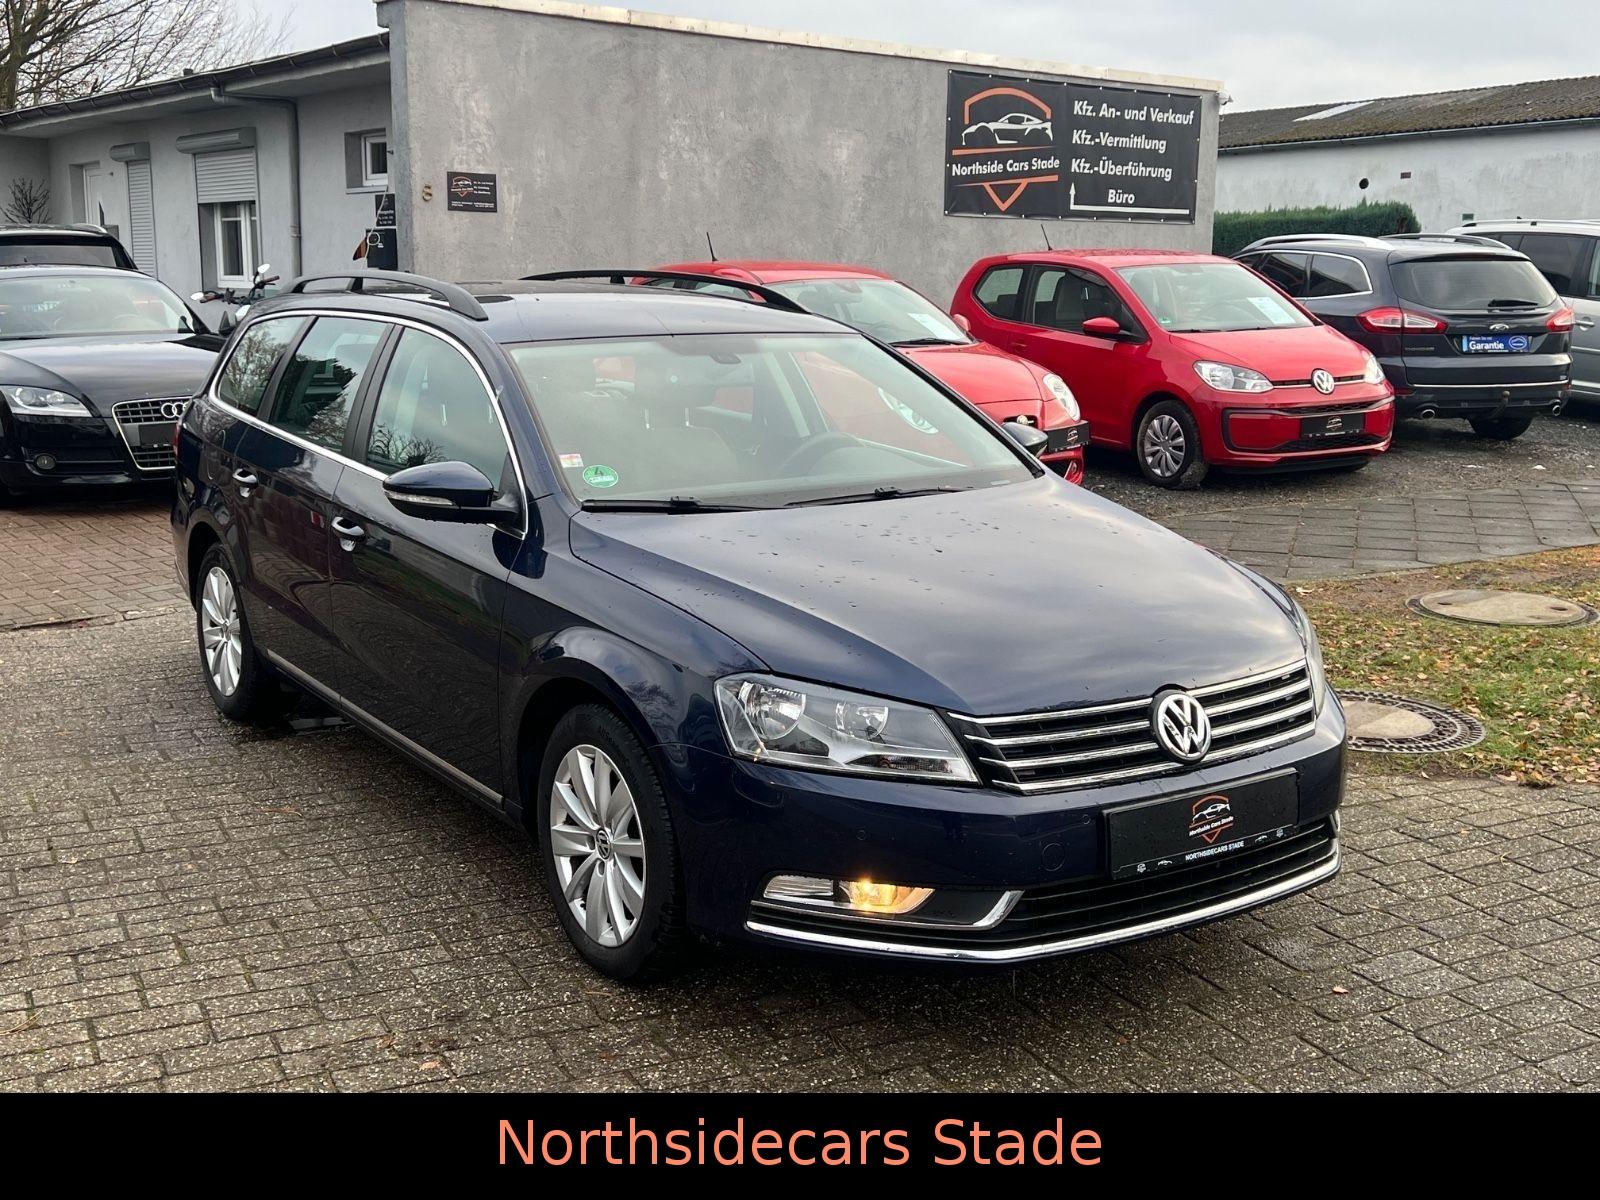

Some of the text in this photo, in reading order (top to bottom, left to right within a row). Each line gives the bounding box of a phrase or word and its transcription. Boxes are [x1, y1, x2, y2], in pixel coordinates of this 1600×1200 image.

[1073, 100, 1195, 125] Kfz. An- und Verkauf
[1072, 130, 1167, 153] Kfz.-Vermittlung
[951, 156, 1060, 176] Northside Cars Stade
[1071, 156, 1173, 181] Kfz.-Überführung
[1107, 189, 1135, 204] Büro
[1469, 341, 1505, 350] Garantie
